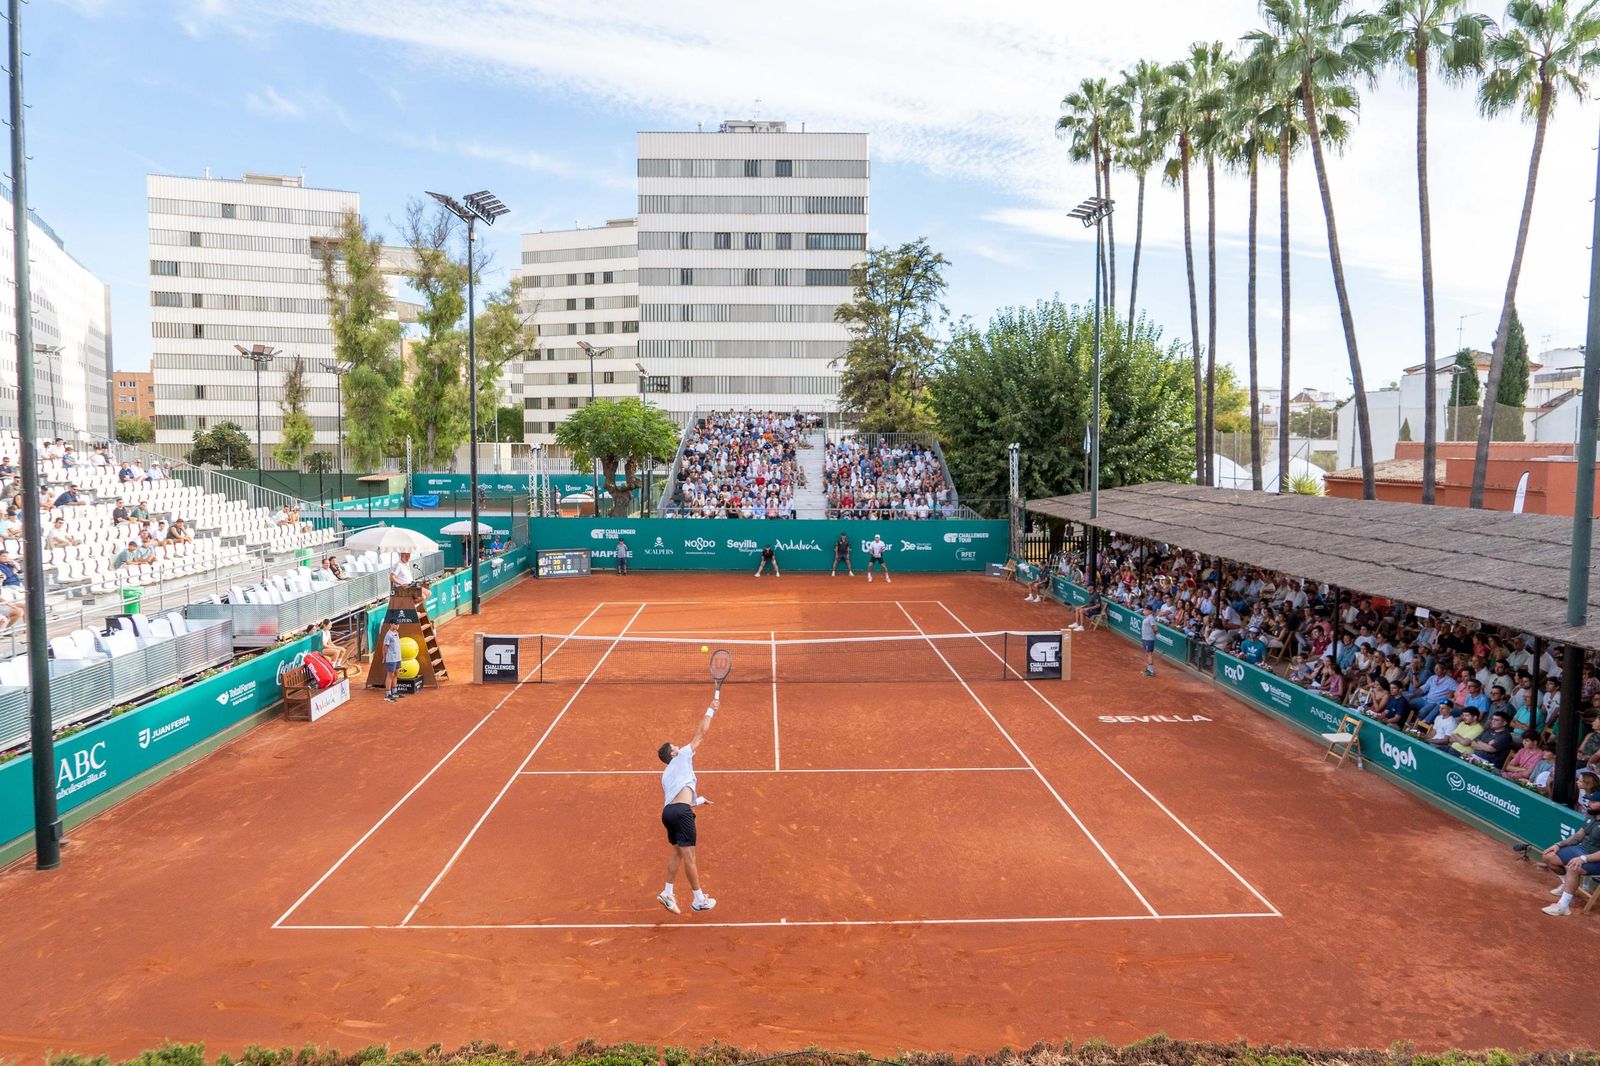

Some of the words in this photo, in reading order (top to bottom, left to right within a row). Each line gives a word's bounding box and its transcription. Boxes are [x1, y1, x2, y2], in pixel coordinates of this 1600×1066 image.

[726, 539, 758, 548] Sevilla
[774, 538, 823, 552] Andalucía
[591, 550, 633, 558] MAPFE
[1097, 715, 1214, 723] SEVILLA
[151, 723, 171, 739] JUAN
[170, 715, 190, 730] FERIA
[55, 740, 107, 789] ABC
[1466, 782, 1521, 816] solocanarias
